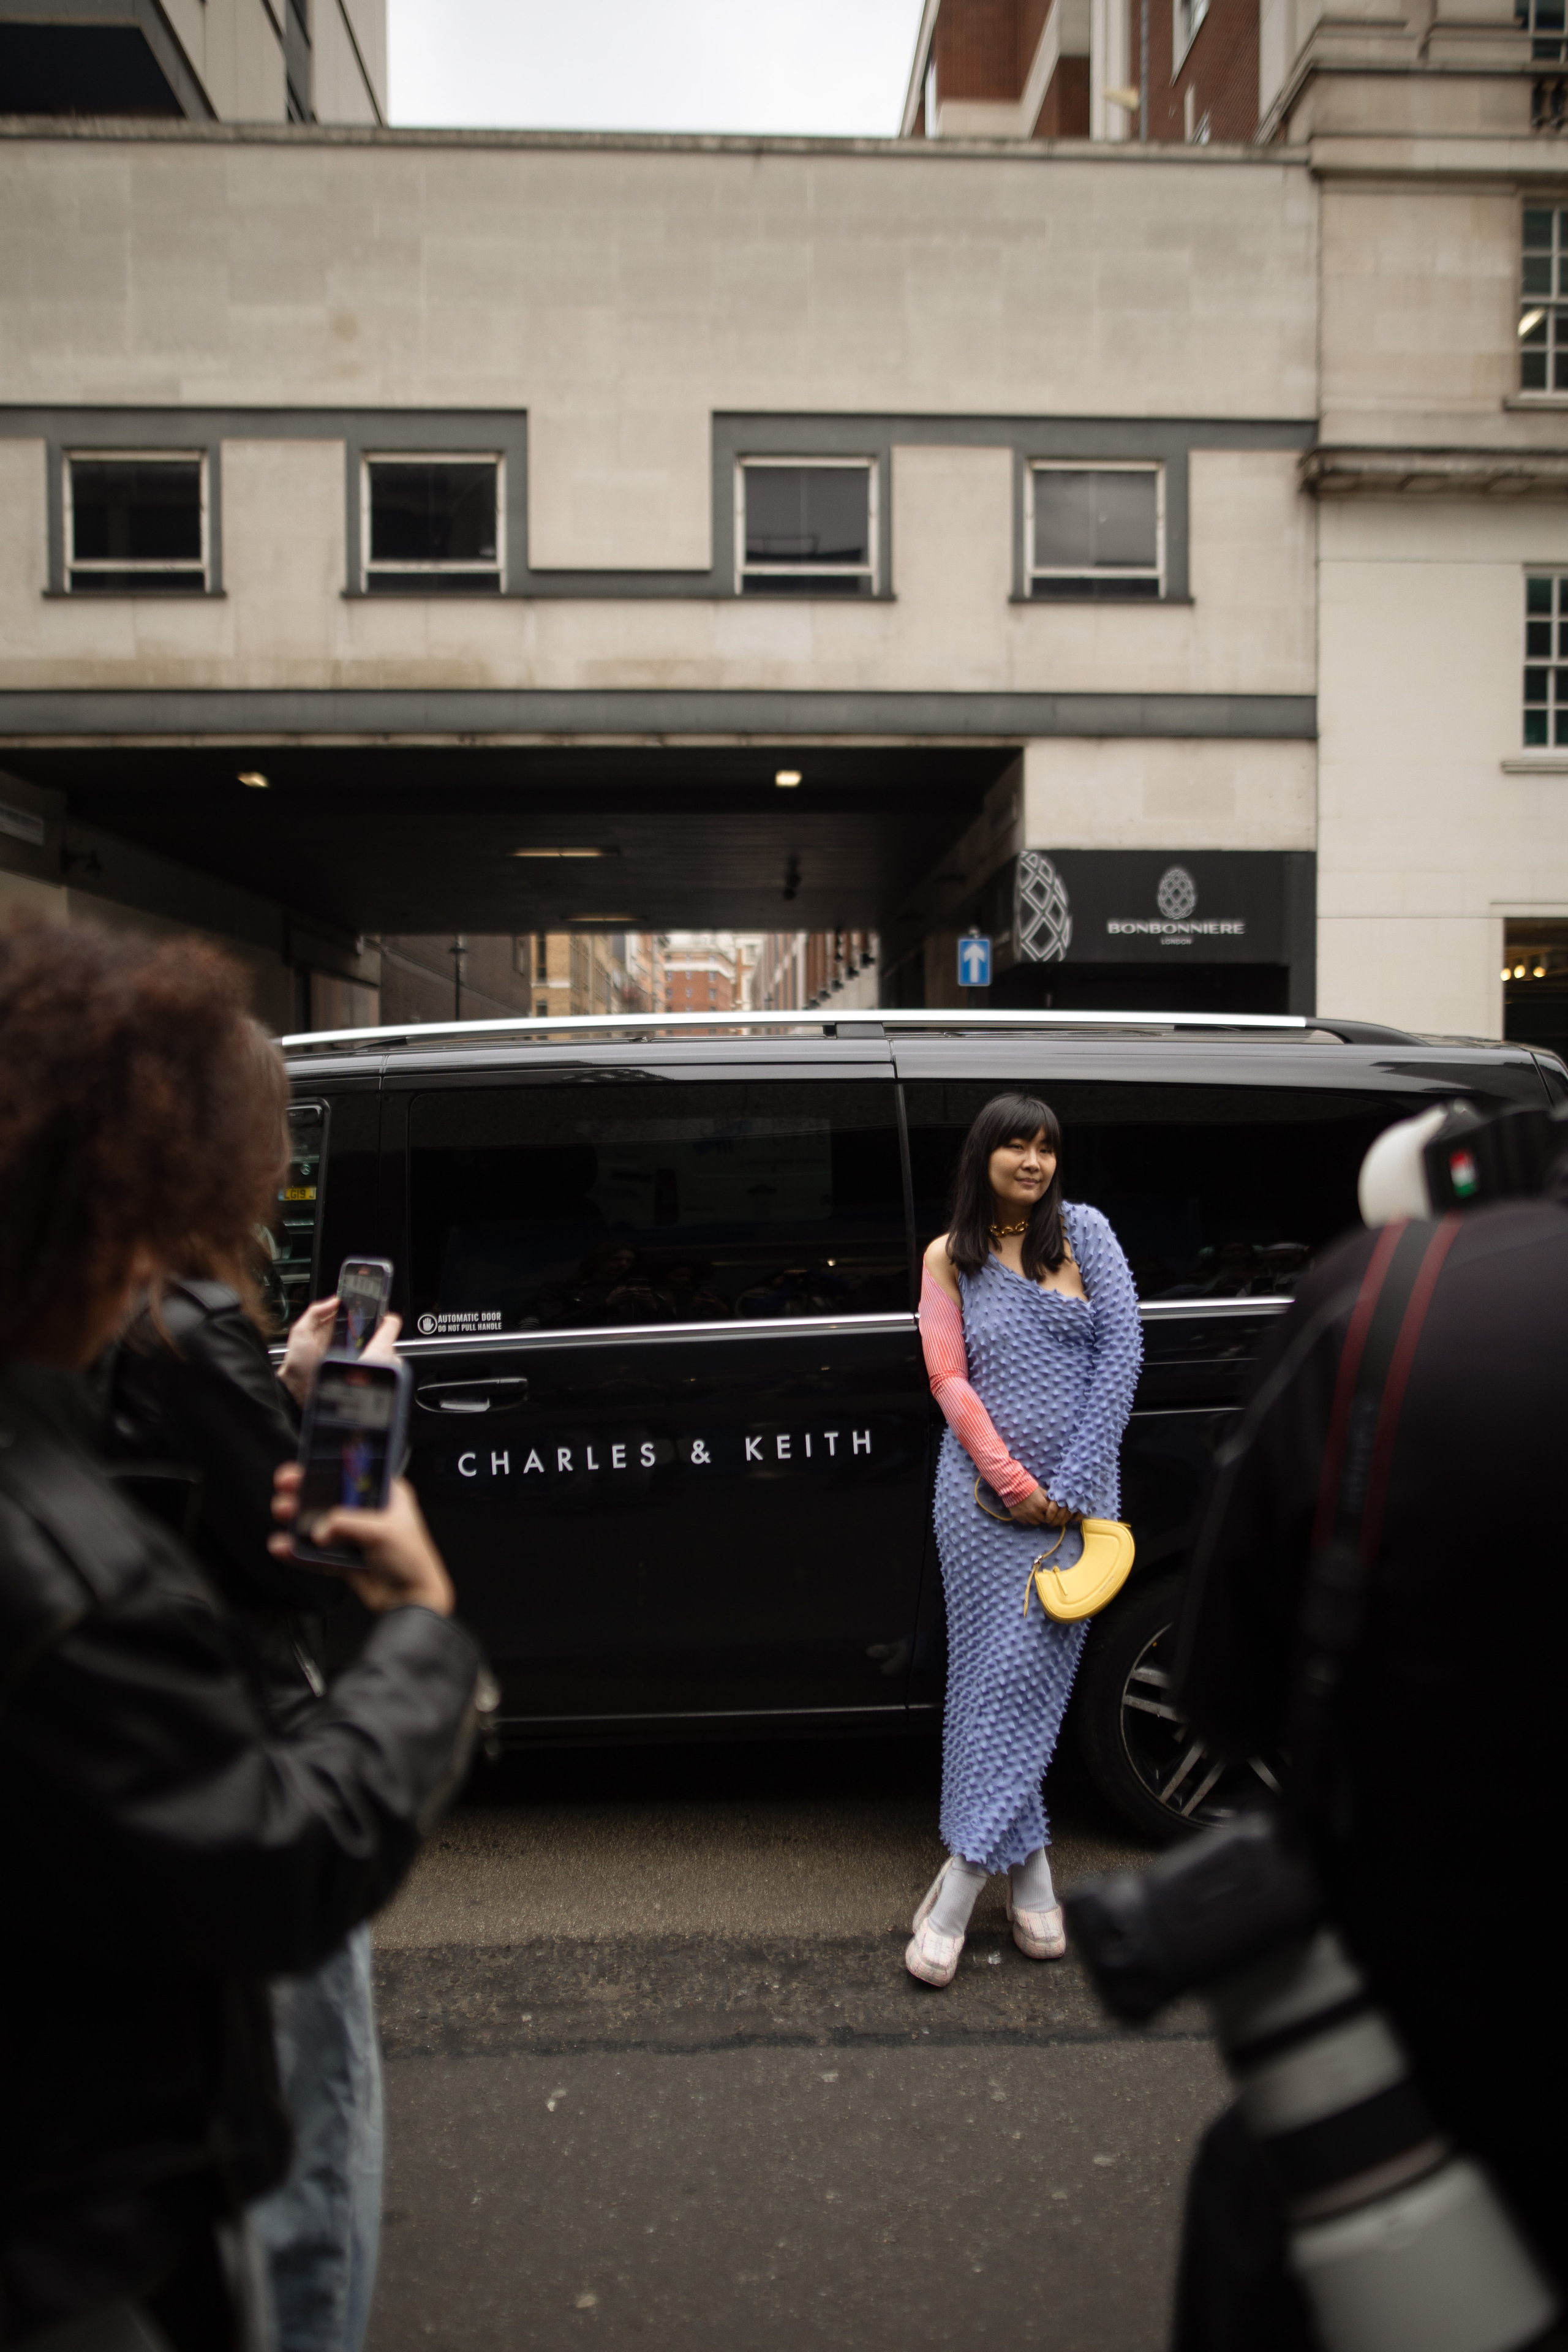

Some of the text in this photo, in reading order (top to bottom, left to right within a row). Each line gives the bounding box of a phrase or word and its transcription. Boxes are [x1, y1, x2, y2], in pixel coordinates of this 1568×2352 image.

[1107, 922, 1245, 934] BONBONNIERE
[438, 1312, 501, 1323] AUTOMATIC DOOR
[458, 1431, 871, 1477] CHARLES & KEITH
